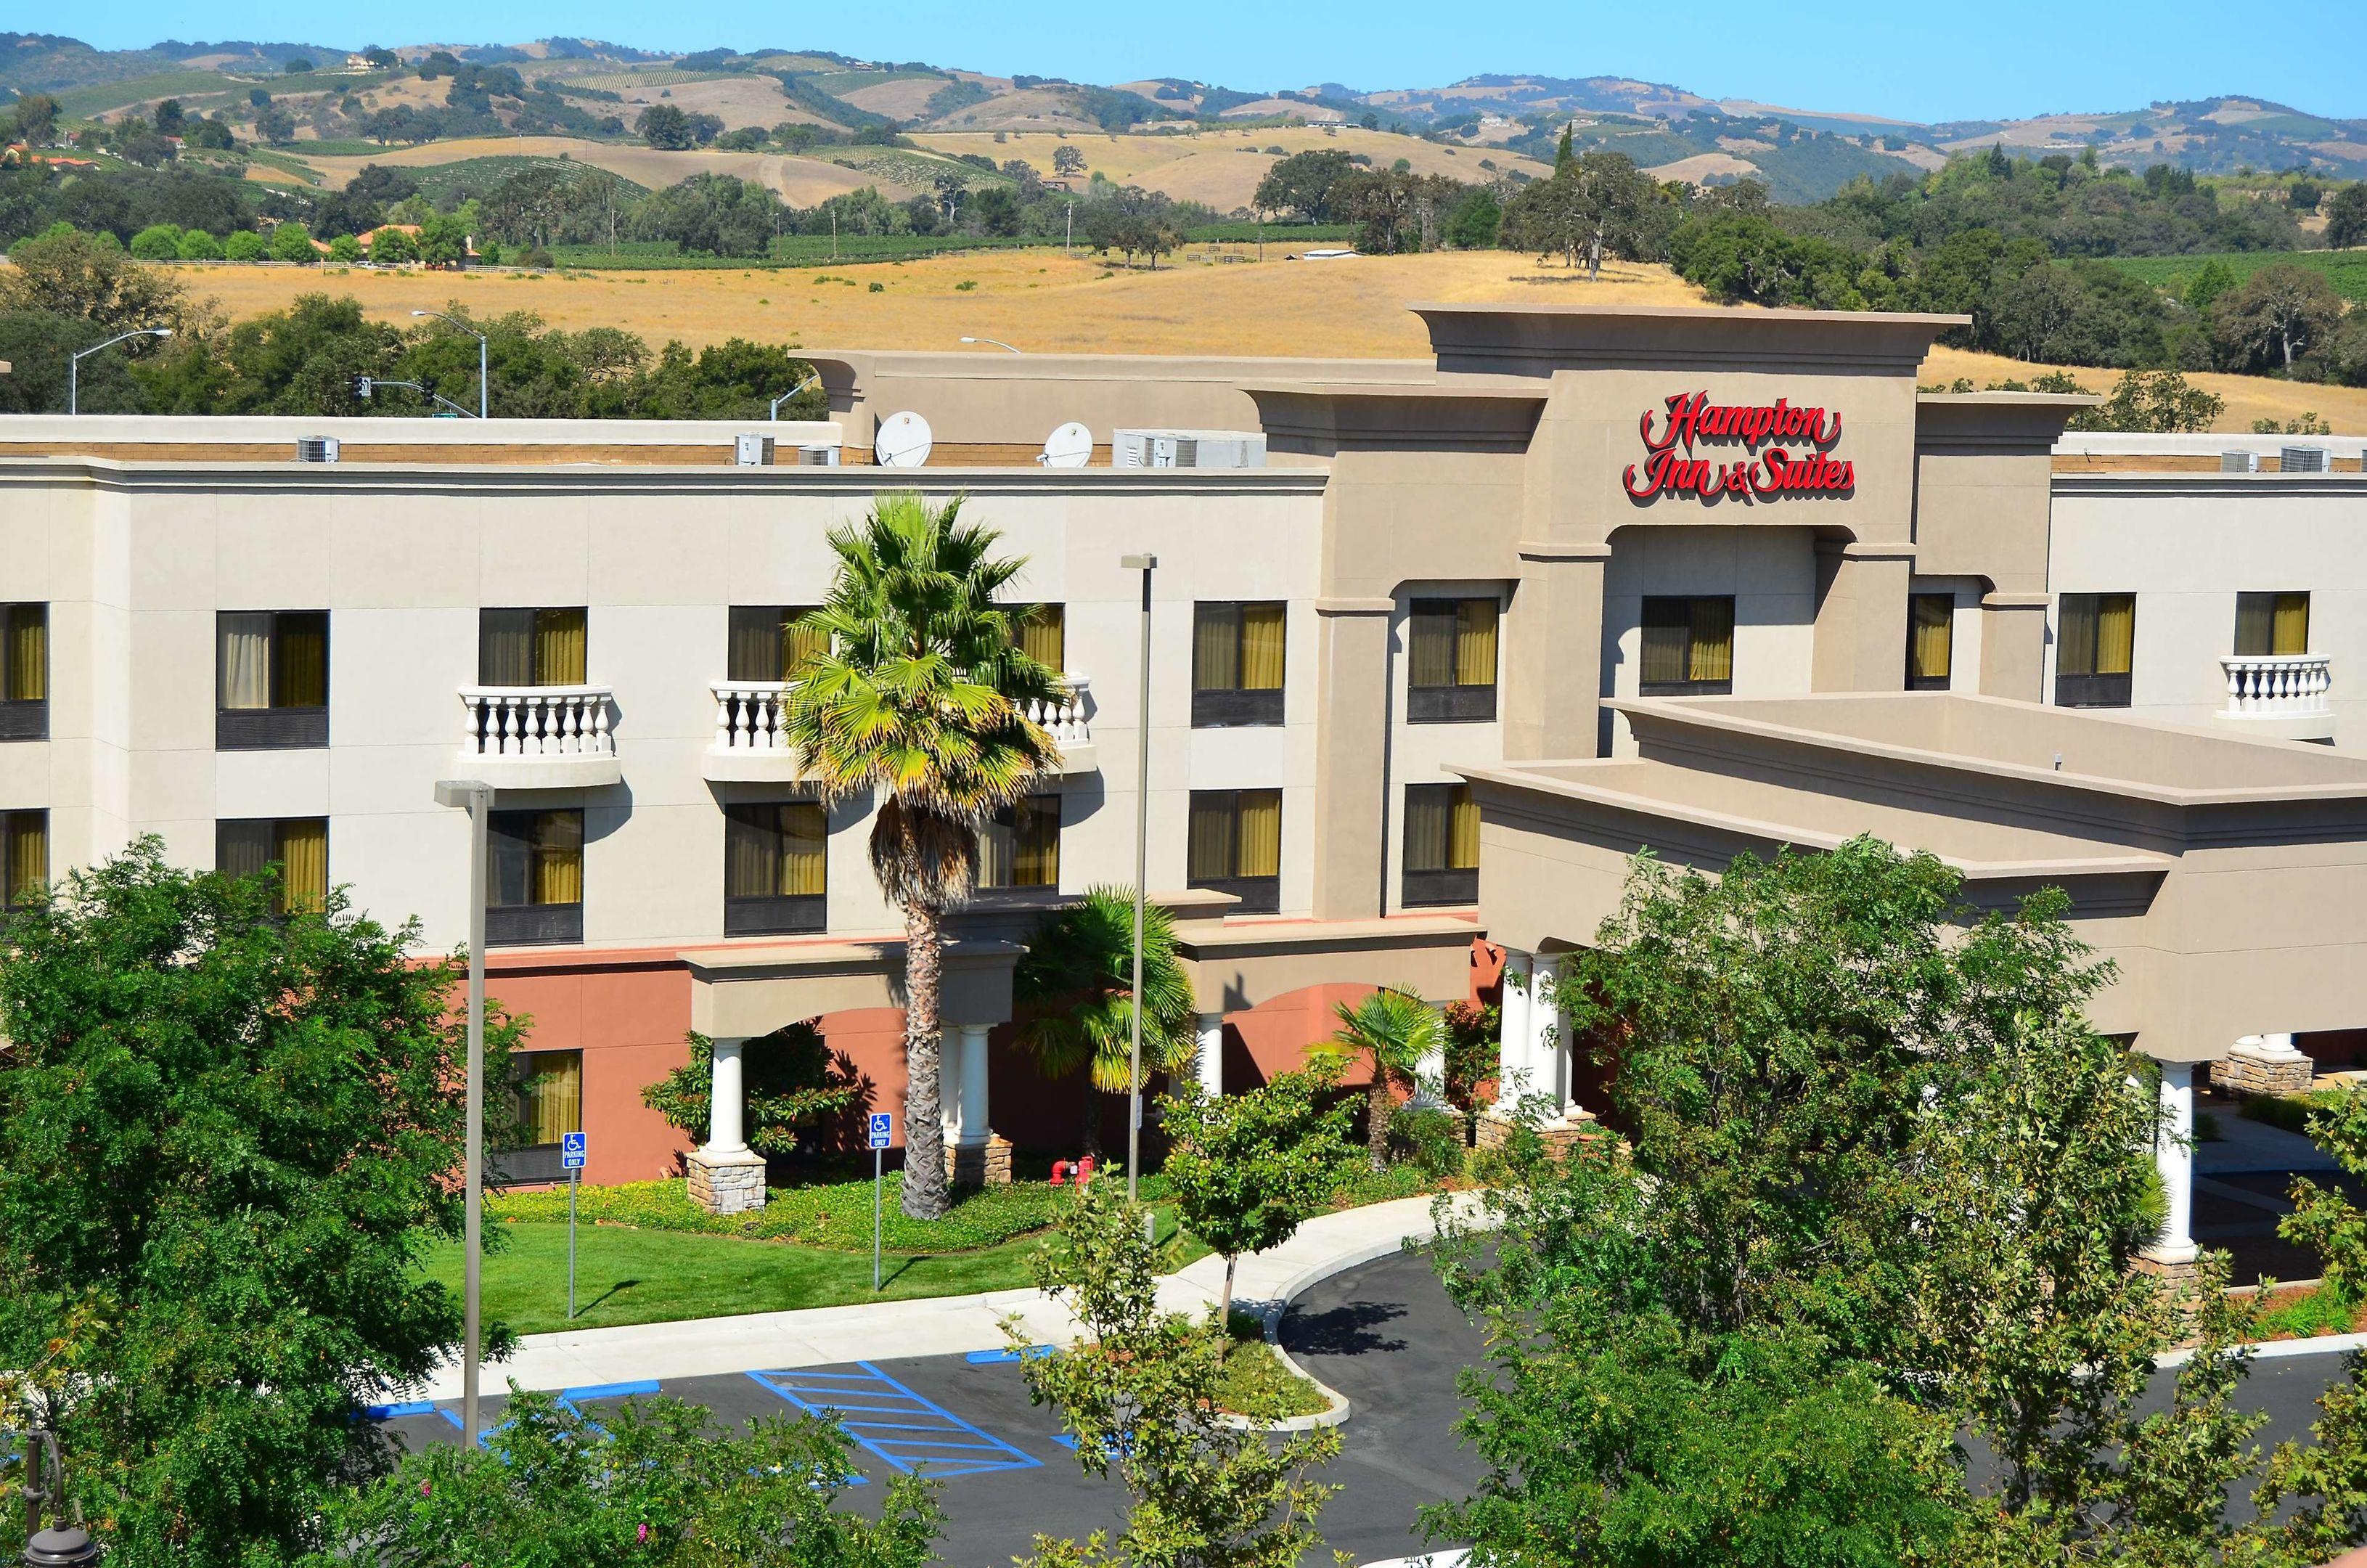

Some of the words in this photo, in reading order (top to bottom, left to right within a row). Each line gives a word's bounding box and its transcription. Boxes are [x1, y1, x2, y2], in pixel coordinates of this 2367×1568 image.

[1640, 390, 1841, 449] Hampton
[1622, 447, 1727, 497] Inn
[1727, 462, 1752, 494] &
[1748, 447, 1855, 492] Suites
